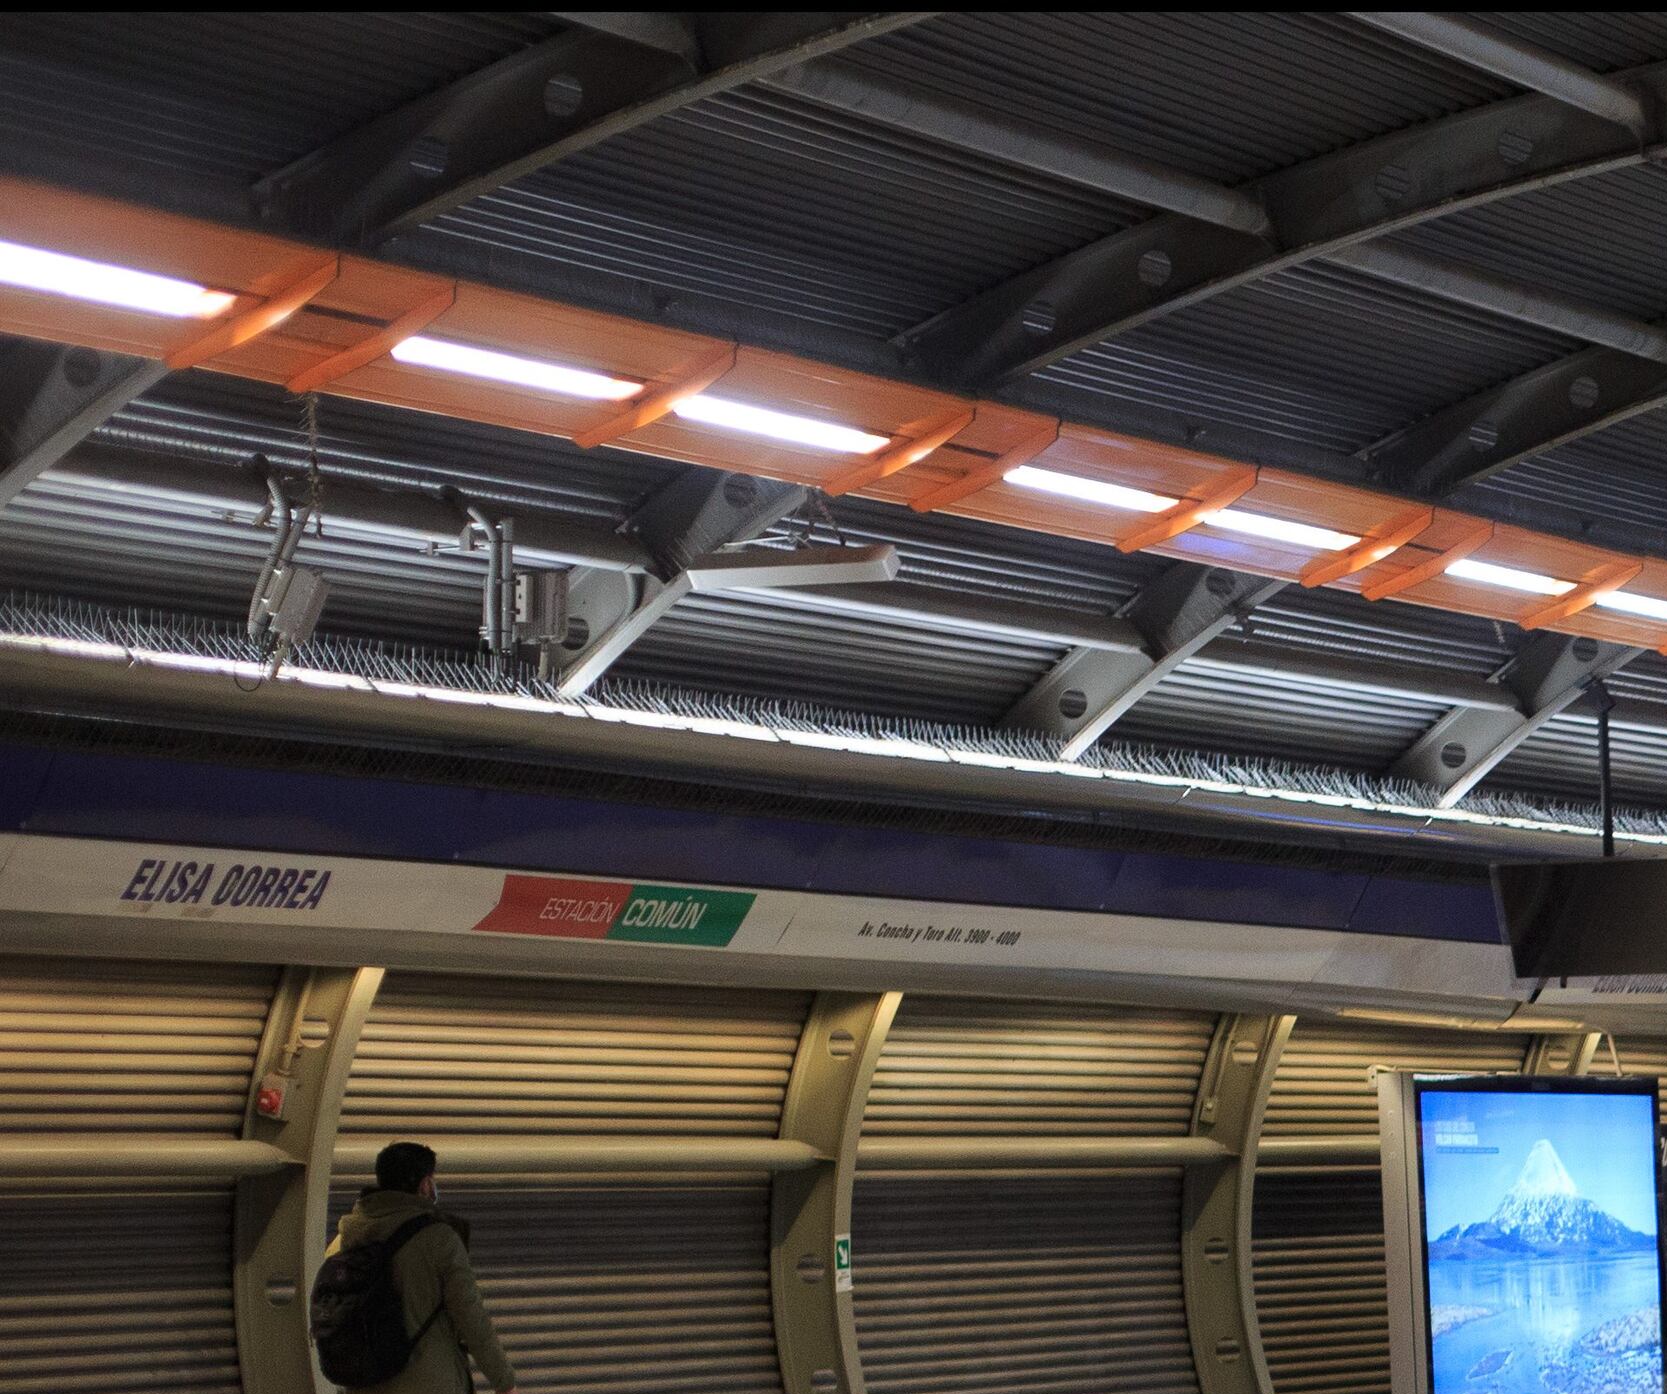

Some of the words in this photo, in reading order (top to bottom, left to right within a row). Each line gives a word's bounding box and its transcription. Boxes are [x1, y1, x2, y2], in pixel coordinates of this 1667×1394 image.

[120, 859, 214, 903] ELISA
[539, 896, 621, 923] ESTACIÓN
[622, 896, 707, 929] COMÚN
[857, 921, 874, 937] Av.
[876, 922, 914, 939] Concha
[912, 929, 923, 943] y
[923, 926, 945, 941] Toro
[964, 928, 991, 944] 3900
[996, 931, 1022, 946] 4000
